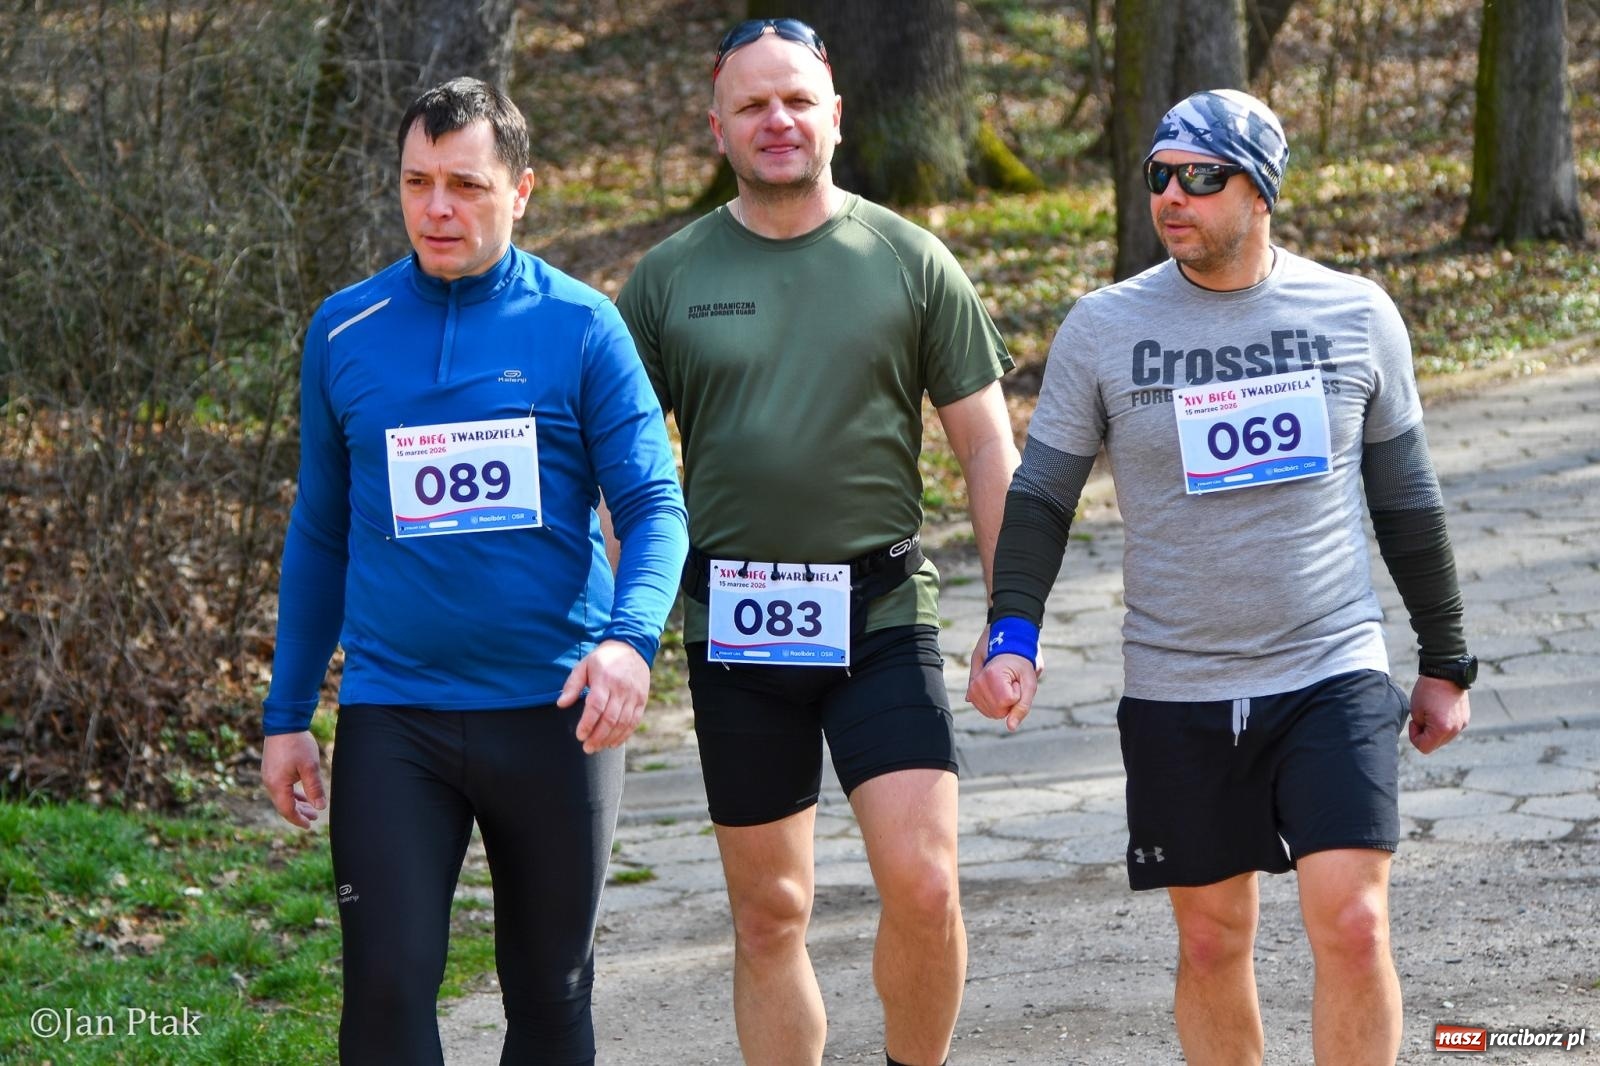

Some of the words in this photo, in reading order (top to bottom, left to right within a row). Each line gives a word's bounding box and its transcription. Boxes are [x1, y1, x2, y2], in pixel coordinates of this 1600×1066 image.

[1132, 329, 1338, 386] CrossFit
[1131, 388, 1175, 408] FORG
[1184, 394, 1204, 407] XIV
[1209, 390, 1236, 403] BIEG
[1240, 380, 1311, 399] TWARDZIELA
[1194, 406, 1218, 415] marzec
[1219, 402, 1238, 411] 2026
[397, 436, 415, 447] XIV
[419, 434, 446, 446] BIEG
[451, 428, 524, 443] TWARDZIELA
[1207, 412, 1302, 461] 069
[405, 448, 428, 457] marzec
[429, 446, 447, 454] 2026
[415, 460, 511, 506] 089
[720, 568, 738, 579] XIV
[750, 581, 767, 589] 2026
[734, 598, 823, 638] 083
